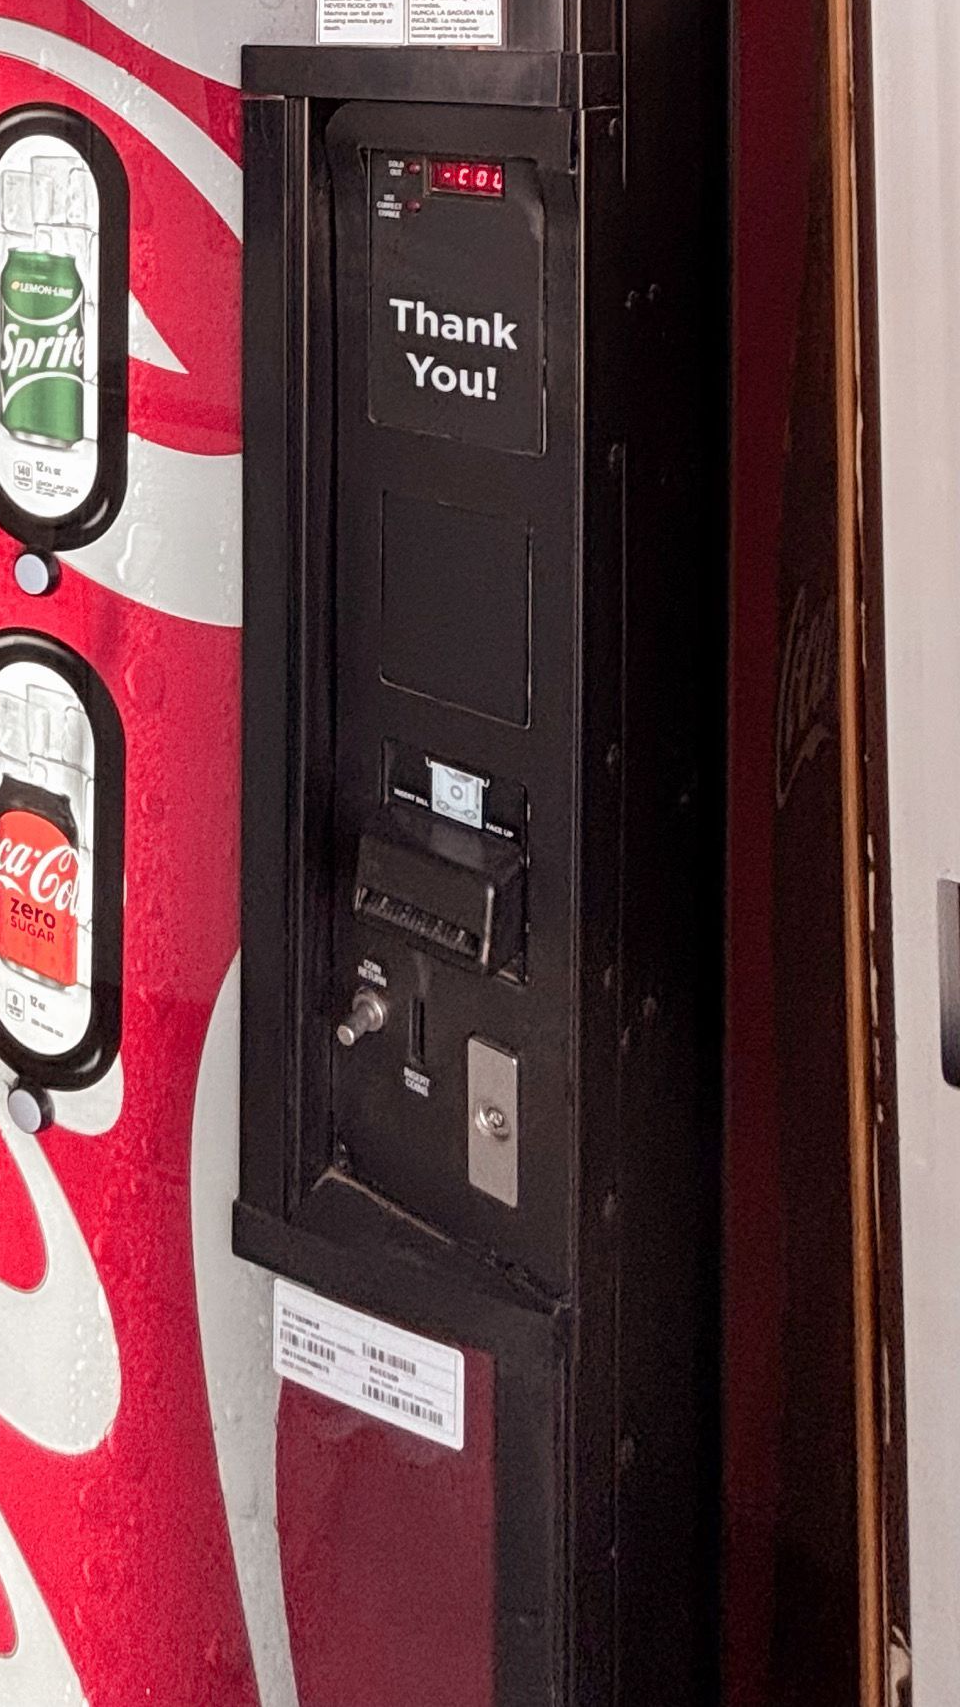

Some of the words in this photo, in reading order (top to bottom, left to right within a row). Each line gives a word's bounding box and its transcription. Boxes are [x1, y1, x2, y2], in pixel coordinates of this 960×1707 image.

[20, 282, 74, 299] LEMON-LIME
[389, 298, 518, 351] Thank
[0, 323, 84, 377] Sprite
[406, 352, 497, 401] You!
[10, 897, 56, 929] zero
[10, 916, 56, 944] SUGAR
